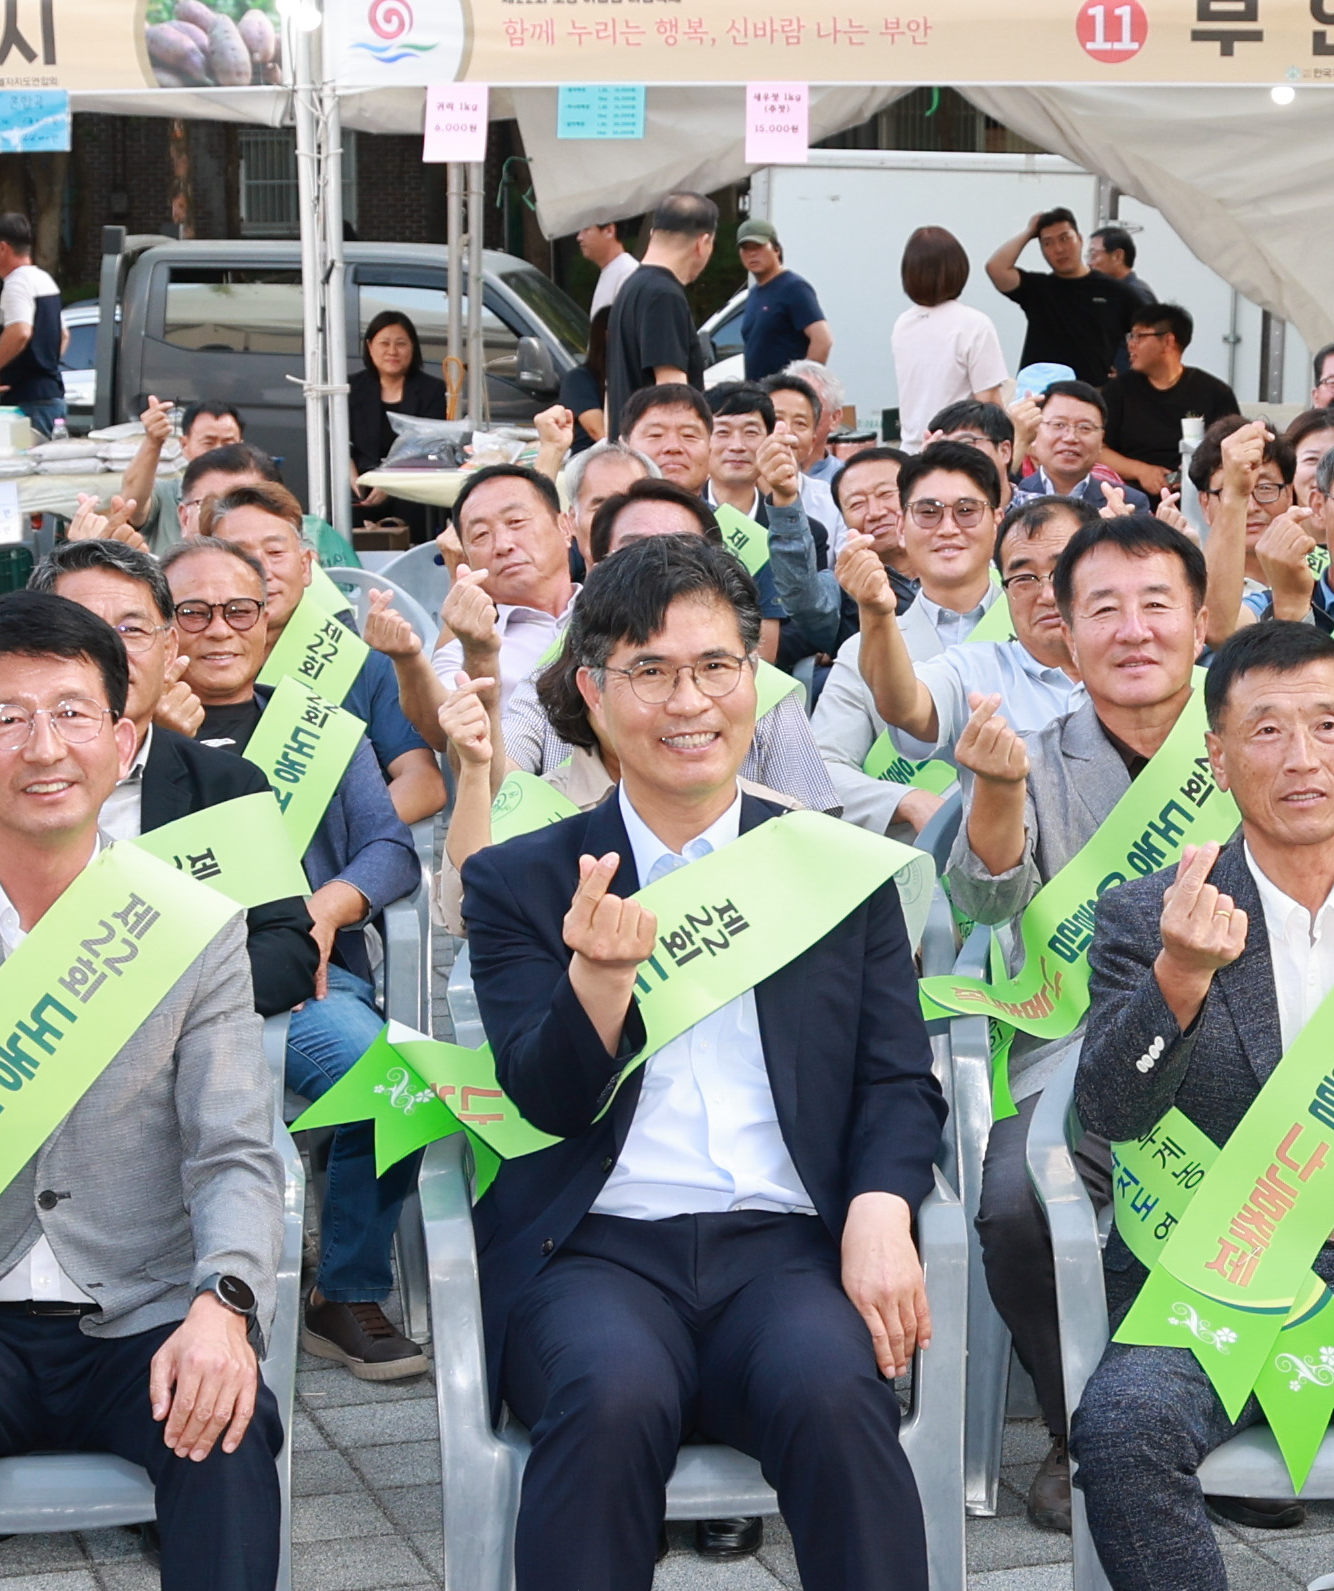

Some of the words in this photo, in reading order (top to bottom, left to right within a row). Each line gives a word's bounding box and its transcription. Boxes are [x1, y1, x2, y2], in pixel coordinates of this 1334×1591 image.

[502, 17, 555, 47] 함께
[566, 17, 646, 47] 누리는
[655, 16, 717, 47] 행복,
[725, 16, 806, 46] 신바람
[816, 16, 869, 46] 나는
[879, 15, 933, 46] 부안
[1085, 6, 1140, 51] 11
[299, 619, 343, 680] 제22회
[273, 725, 321, 784] 도농
[1126, 798, 1194, 876] 도농
[58, 892, 161, 1004] 제22회
[658, 898, 750, 968] 제22회
[1201, 1121, 1330, 1288] 나눔축제
